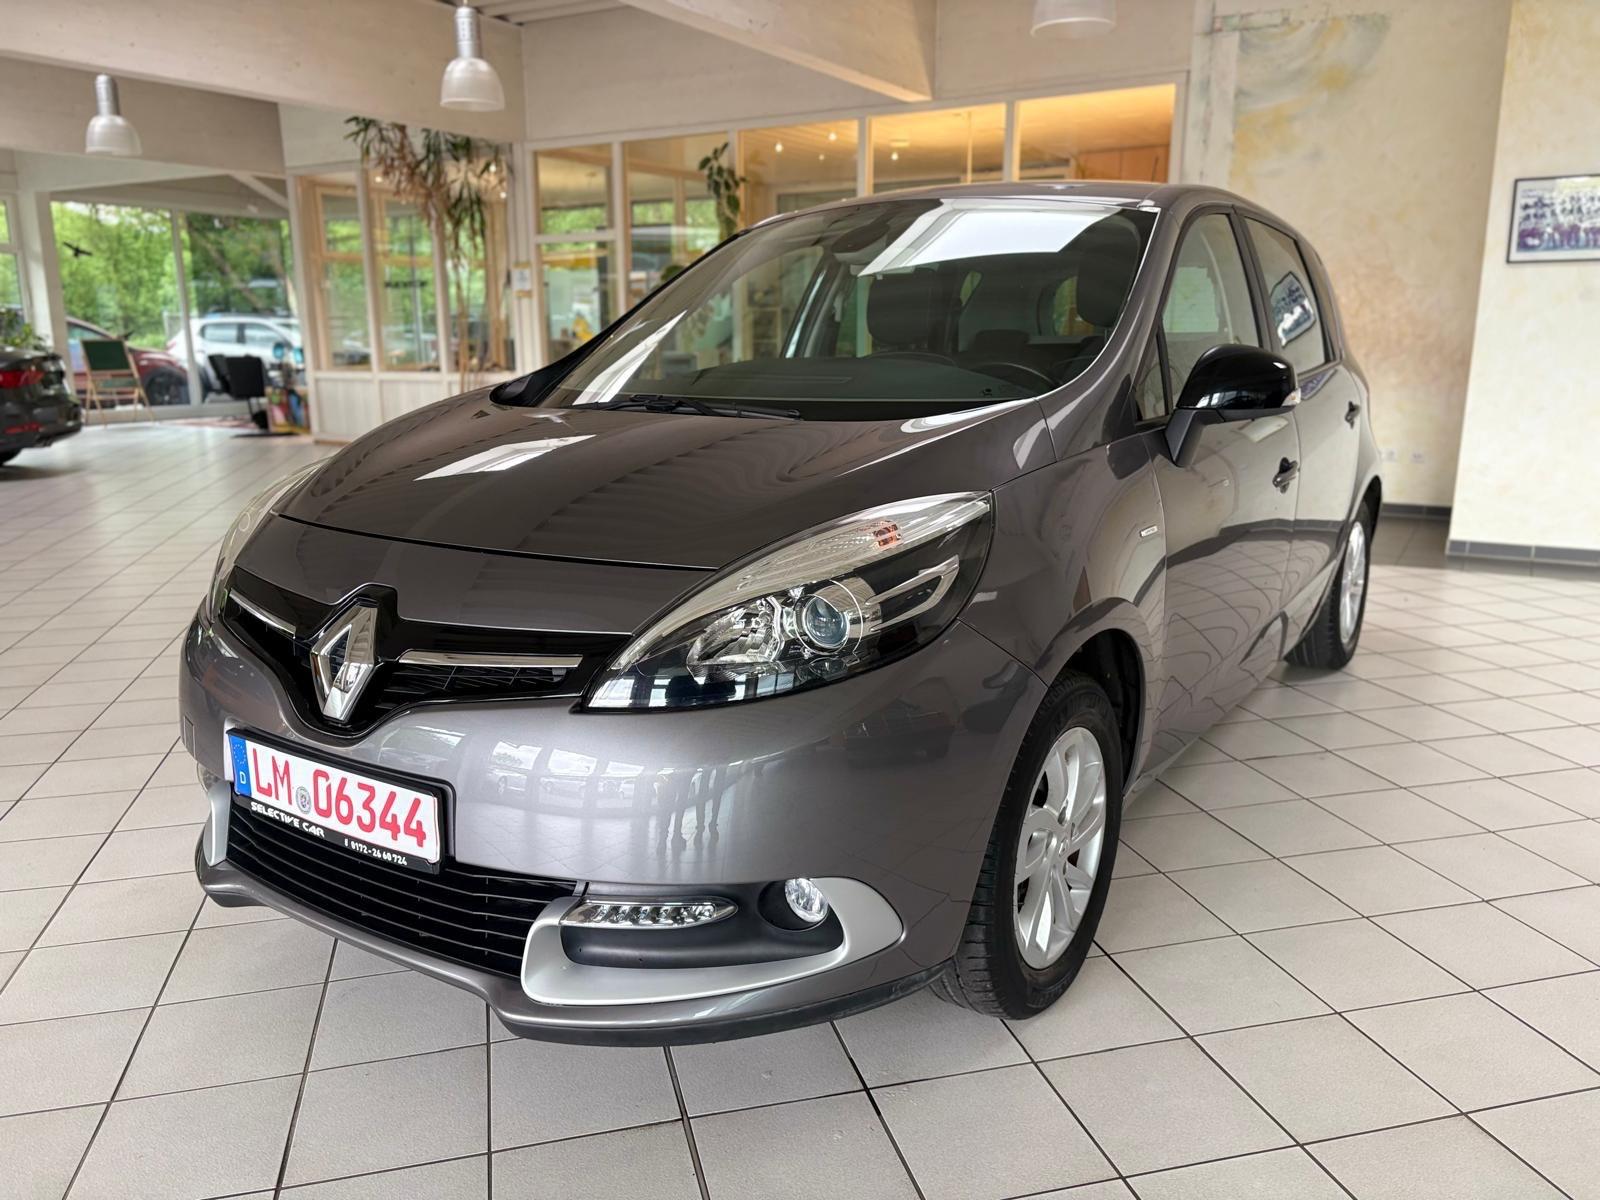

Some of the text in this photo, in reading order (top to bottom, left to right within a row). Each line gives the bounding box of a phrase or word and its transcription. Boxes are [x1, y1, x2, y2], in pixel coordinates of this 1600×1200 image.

[240, 771, 247, 784] D
[252, 748, 427, 848] LM 06344
[250, 802, 325, 838] SELECTIVE CAR
